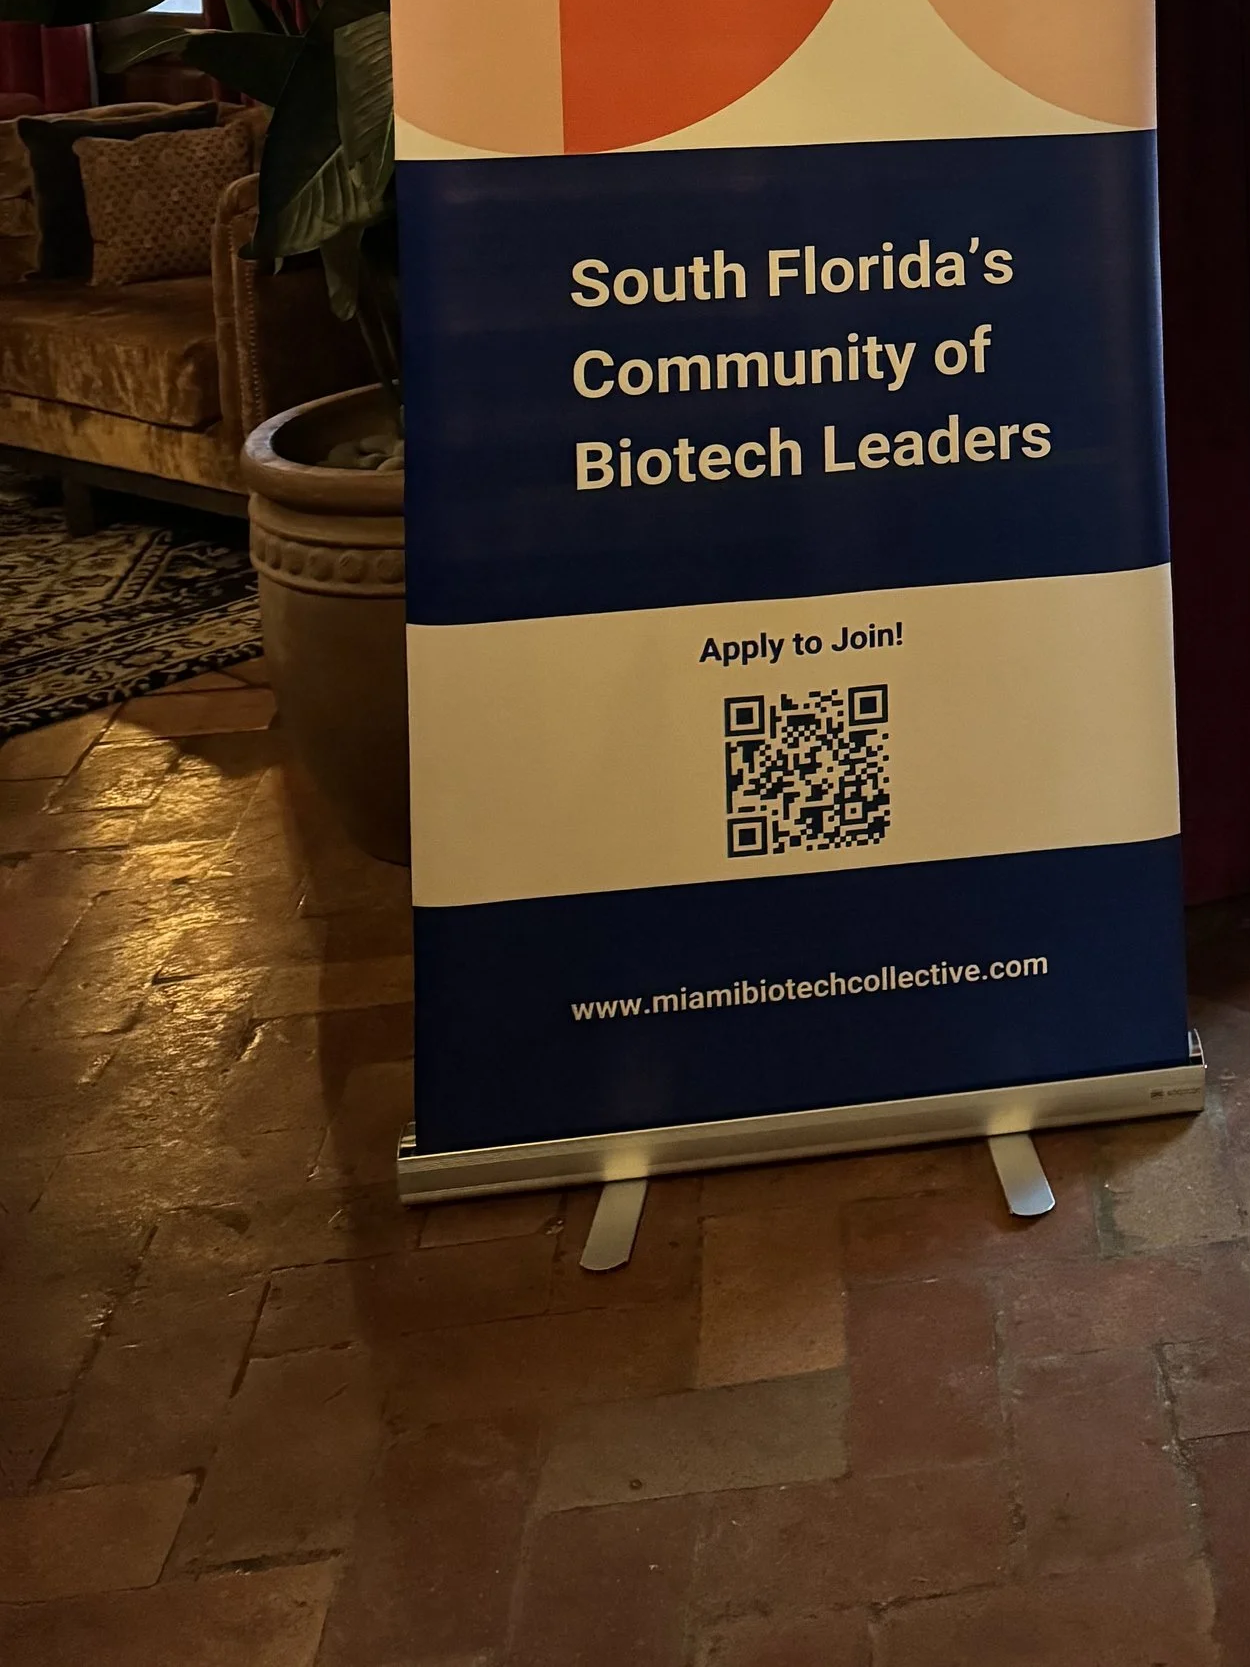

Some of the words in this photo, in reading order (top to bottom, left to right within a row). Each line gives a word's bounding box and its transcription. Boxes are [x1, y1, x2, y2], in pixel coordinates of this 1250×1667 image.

[570, 250, 747, 307] South
[768, 237, 1014, 297] Florida’s
[572, 332, 916, 399] Community
[934, 324, 992, 375] of
[575, 427, 803, 491] Biotech
[823, 414, 1052, 473] Leaders
[699, 632, 785, 667] Apply
[792, 633, 823, 656] to
[831, 622, 903, 652] Join!
[571, 954, 1049, 1022] www.miamibiotechcollective.com
